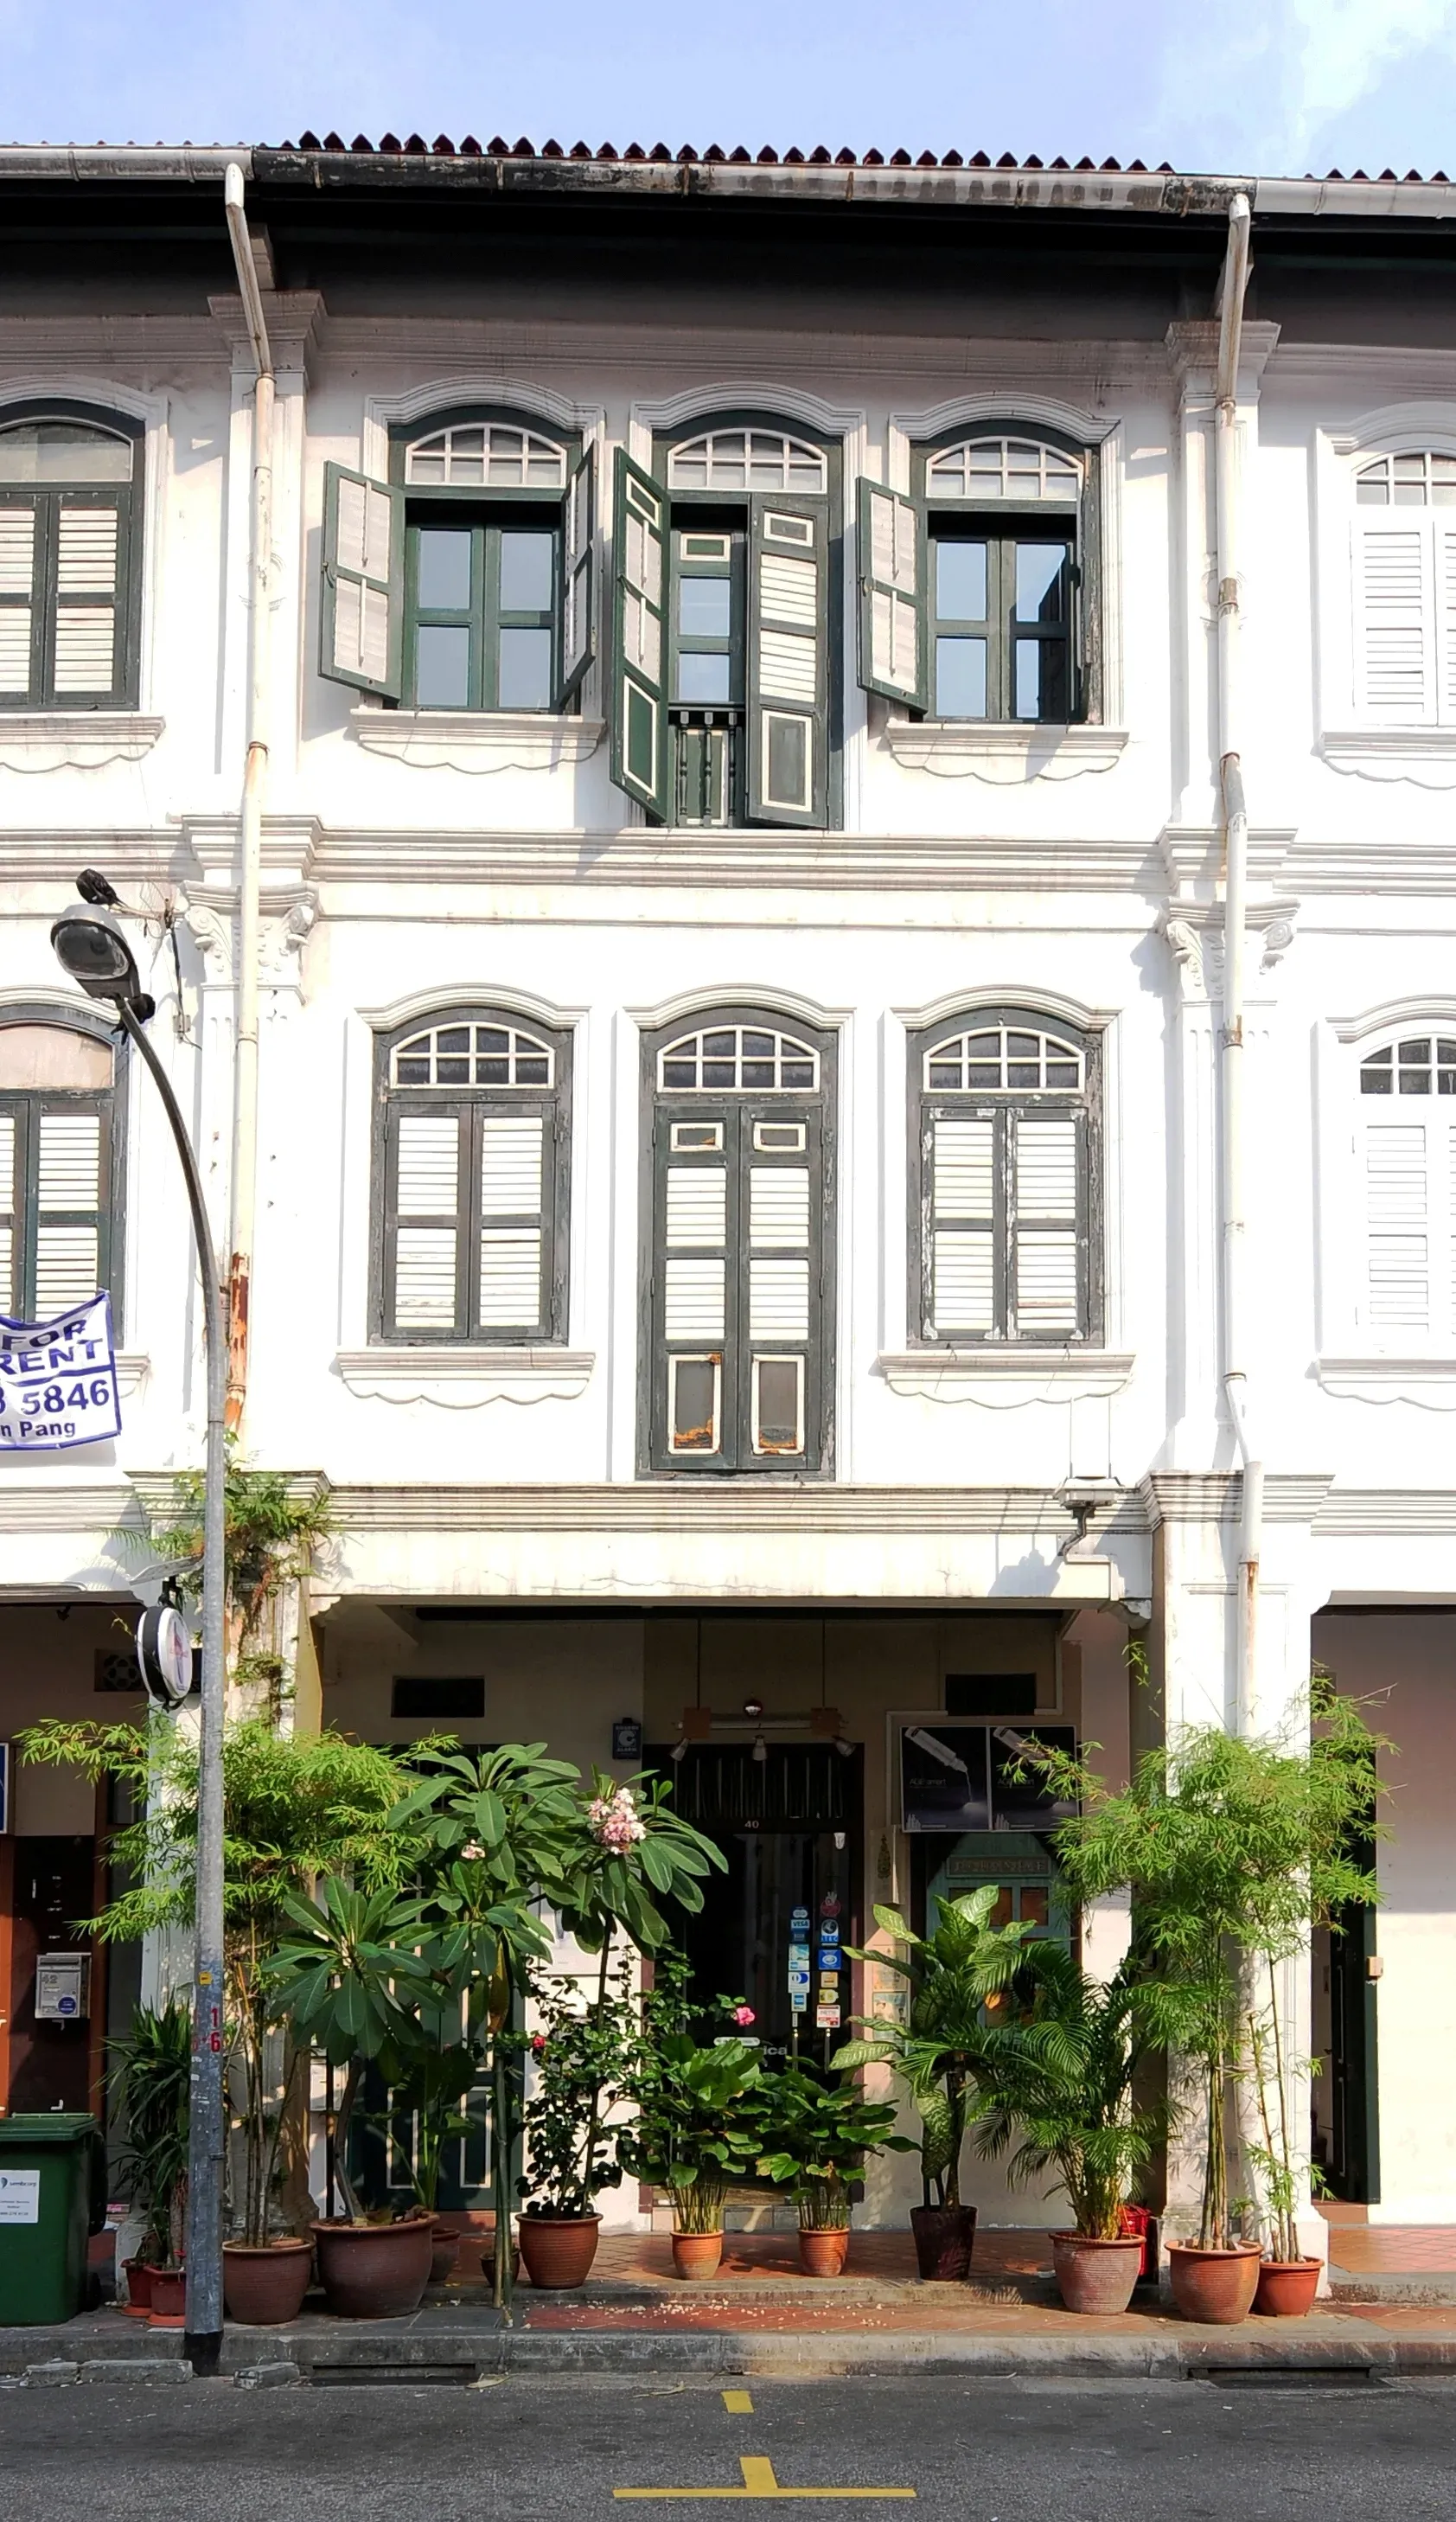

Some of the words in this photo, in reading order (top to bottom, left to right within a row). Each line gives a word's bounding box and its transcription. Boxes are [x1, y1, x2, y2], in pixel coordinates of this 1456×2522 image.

[2, 1319, 87, 1350] FOR
[0, 1338, 104, 1375] RENT
[22, 1379, 110, 1416] 5846
[20, 1421, 76, 1437] Pang
